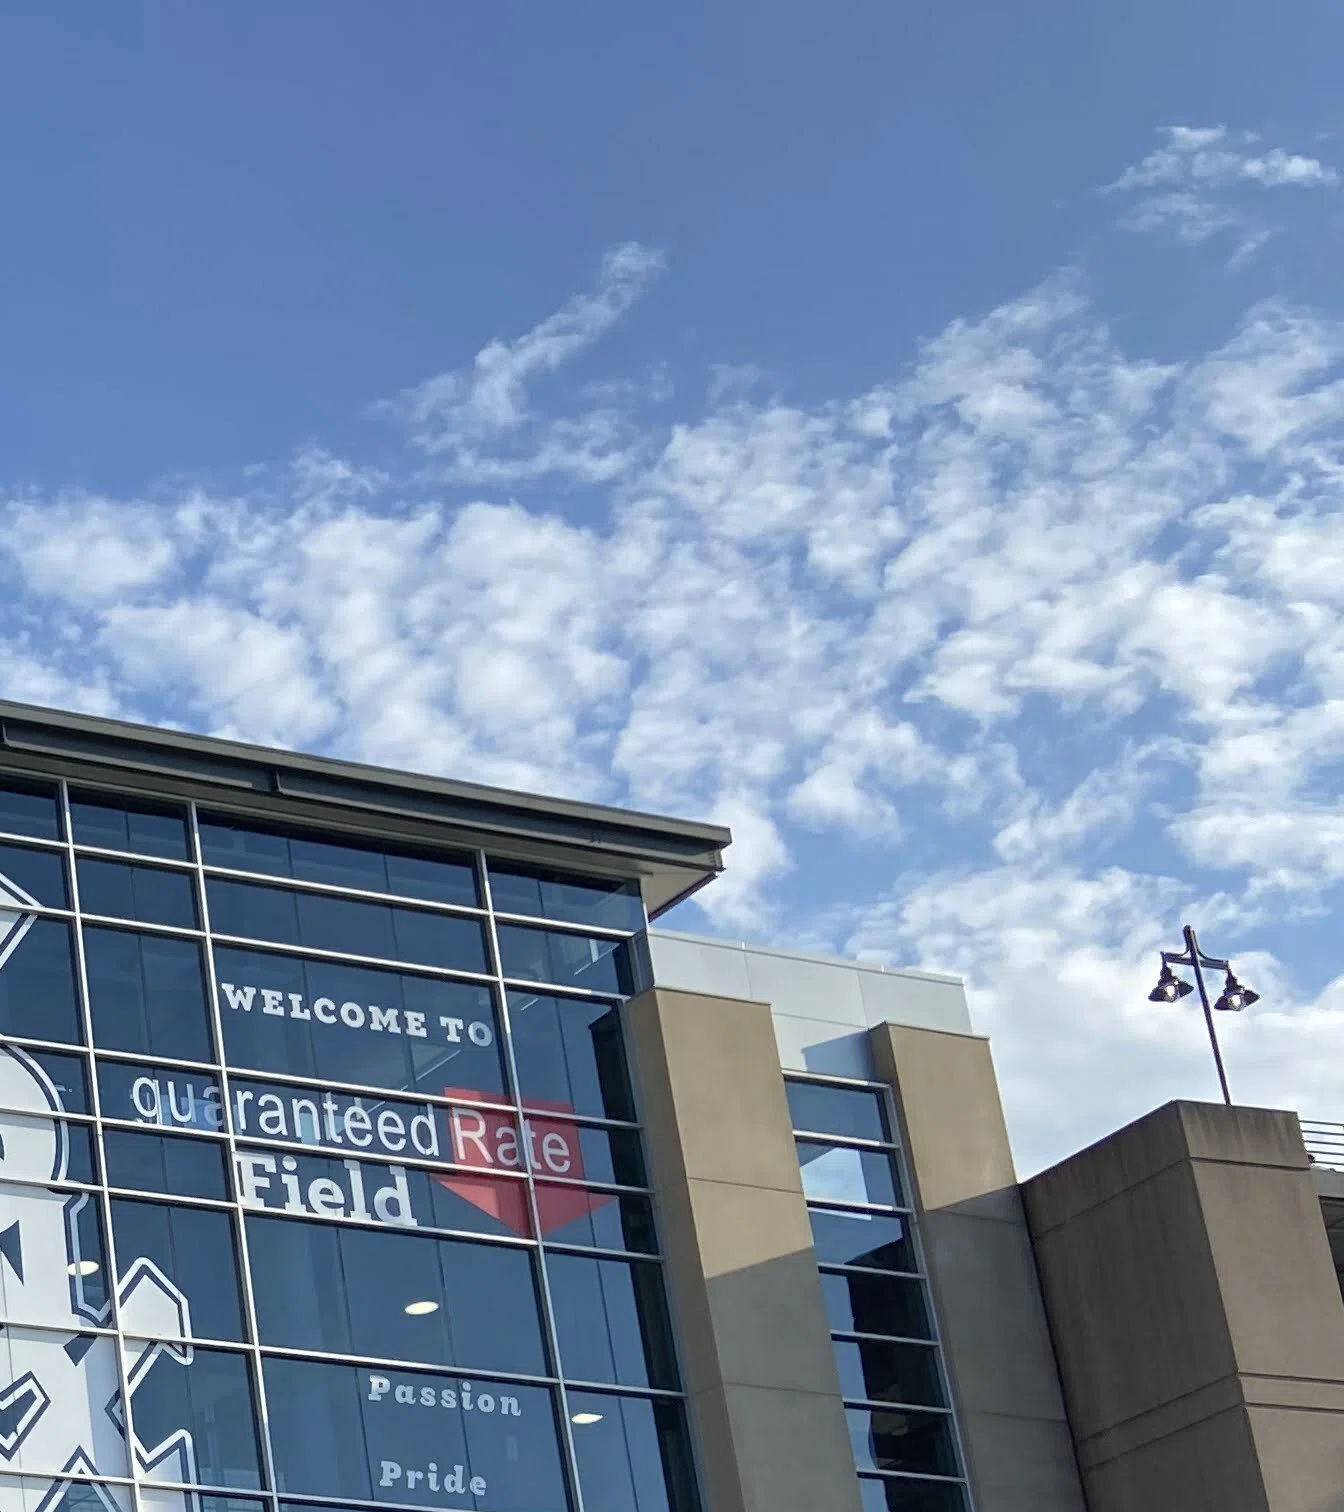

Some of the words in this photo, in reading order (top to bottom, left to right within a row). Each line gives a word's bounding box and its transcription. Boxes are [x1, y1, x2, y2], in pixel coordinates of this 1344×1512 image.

[220, 981, 428, 1039] WELCOME
[438, 1015, 494, 1048] TO
[130, 1075, 440, 1158] guaranteed
[451, 1107, 571, 1174] Rate
[233, 1151, 418, 1227] Field
[368, 1375, 521, 1416] Passion
[379, 1461, 487, 1496] Pride
